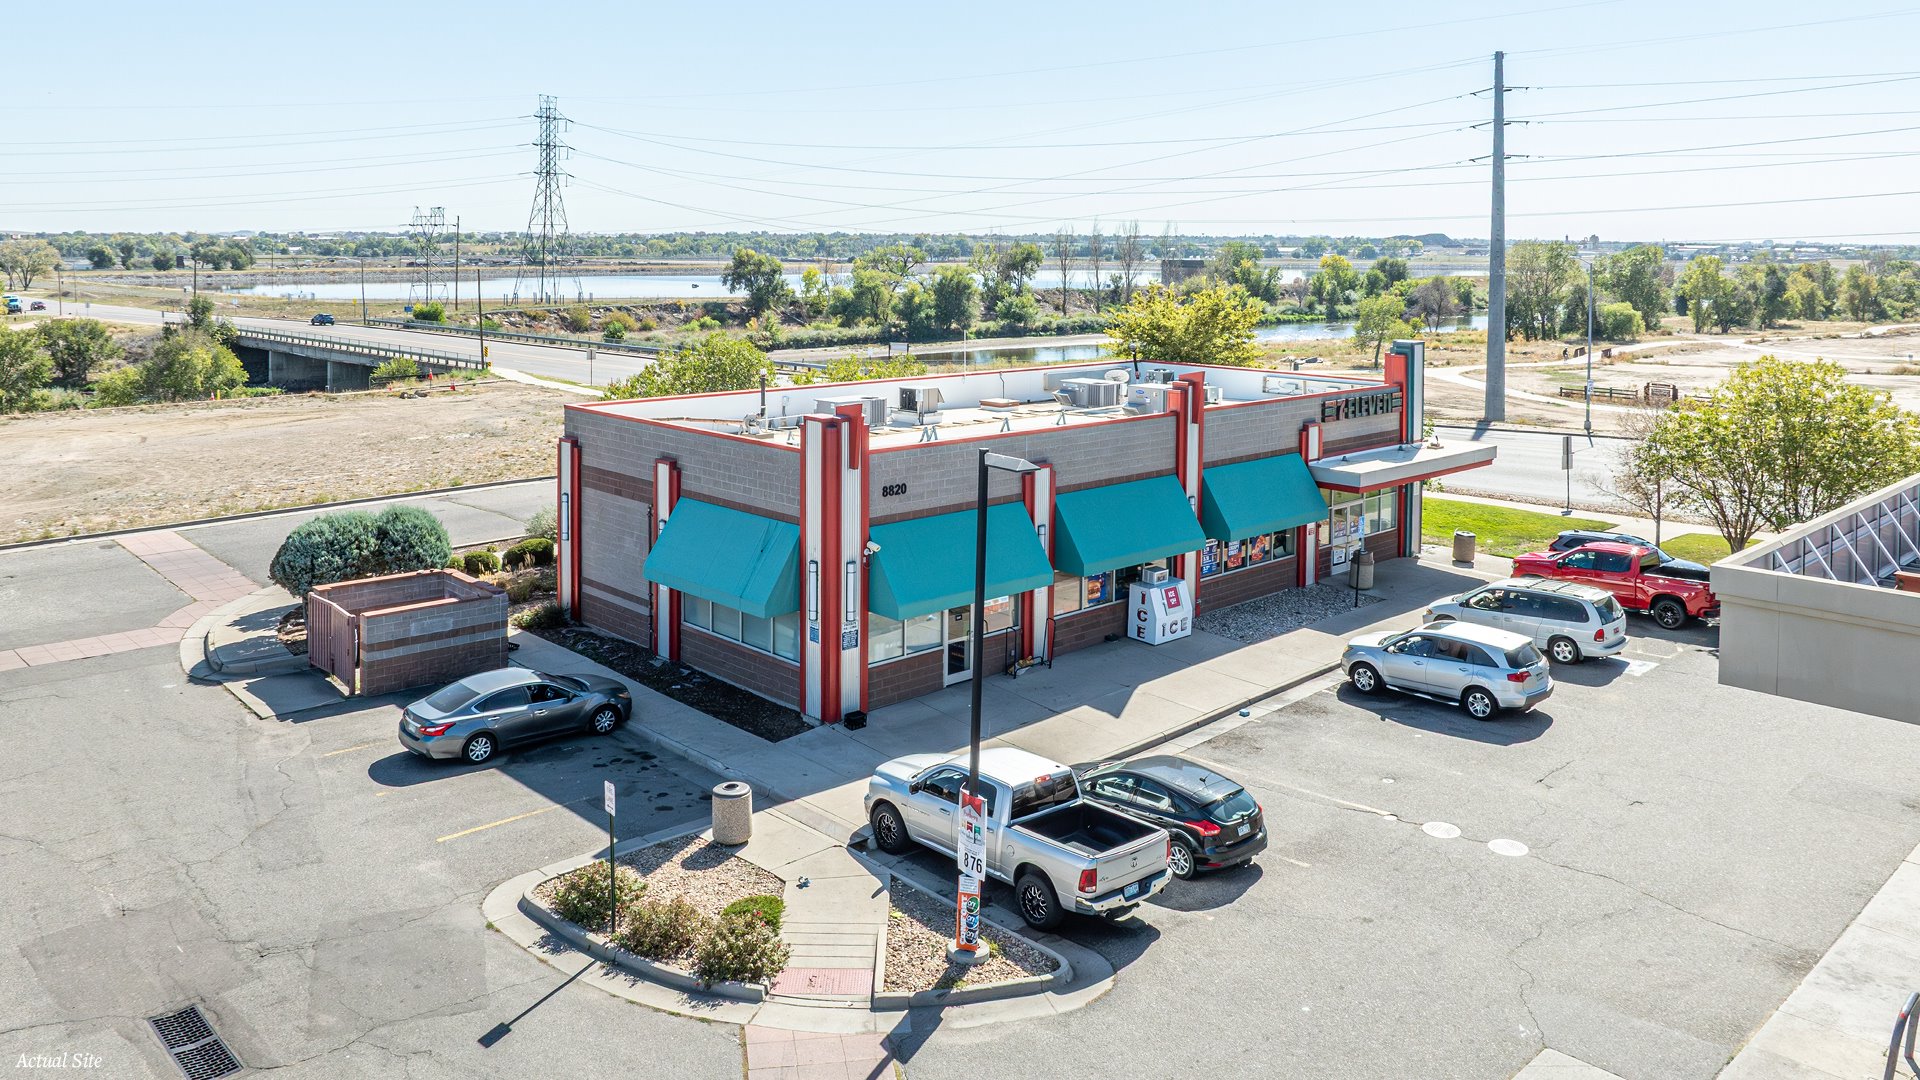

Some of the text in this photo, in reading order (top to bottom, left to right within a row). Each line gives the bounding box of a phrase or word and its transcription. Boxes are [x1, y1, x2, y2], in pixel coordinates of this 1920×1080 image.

[882, 483, 907, 497] 8820
[1137, 591, 1148, 639] ICE
[1162, 617, 1188, 637] ICE
